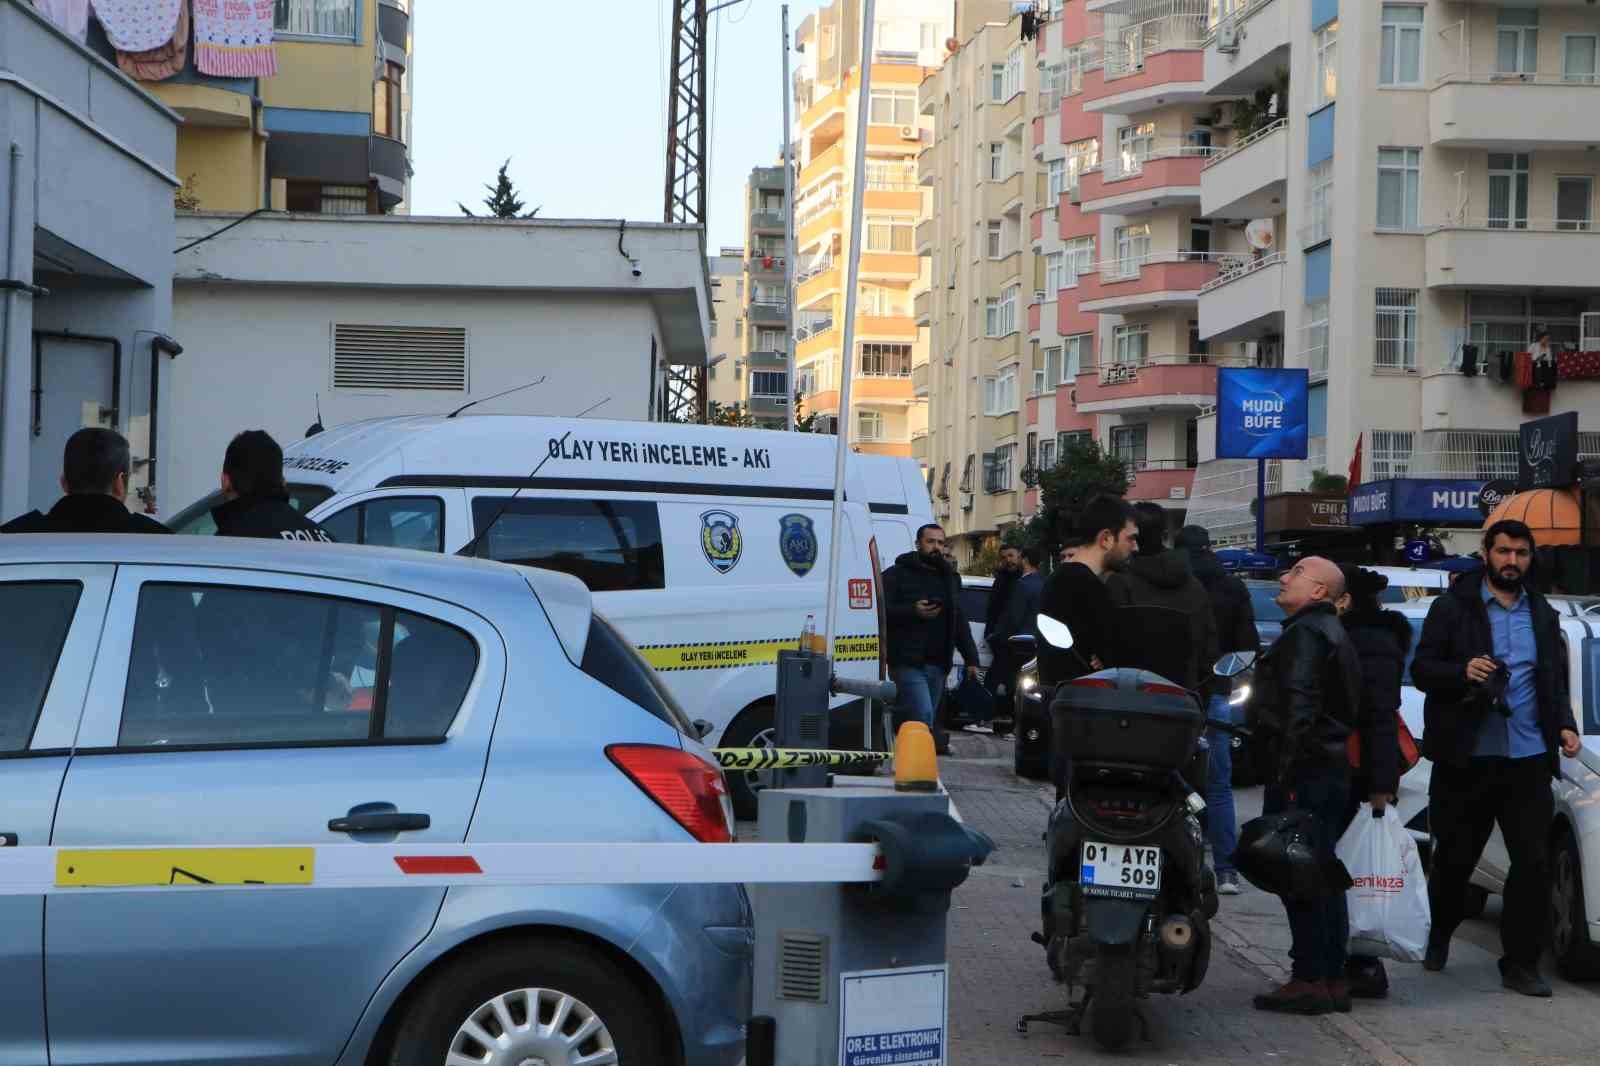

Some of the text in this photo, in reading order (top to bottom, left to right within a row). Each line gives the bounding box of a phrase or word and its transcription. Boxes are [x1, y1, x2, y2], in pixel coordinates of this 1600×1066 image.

[1242, 399, 1284, 414] MUDU
[1244, 412, 1282, 429] BÜFE
[548, 437, 594, 461] OLAY
[1432, 491, 1479, 509] MUD
[852, 582, 869, 597] 112
[1086, 845, 1157, 866] 01 AYR
[1121, 867, 1156, 886] 509
[846, 1036, 877, 1054] OR-EL
